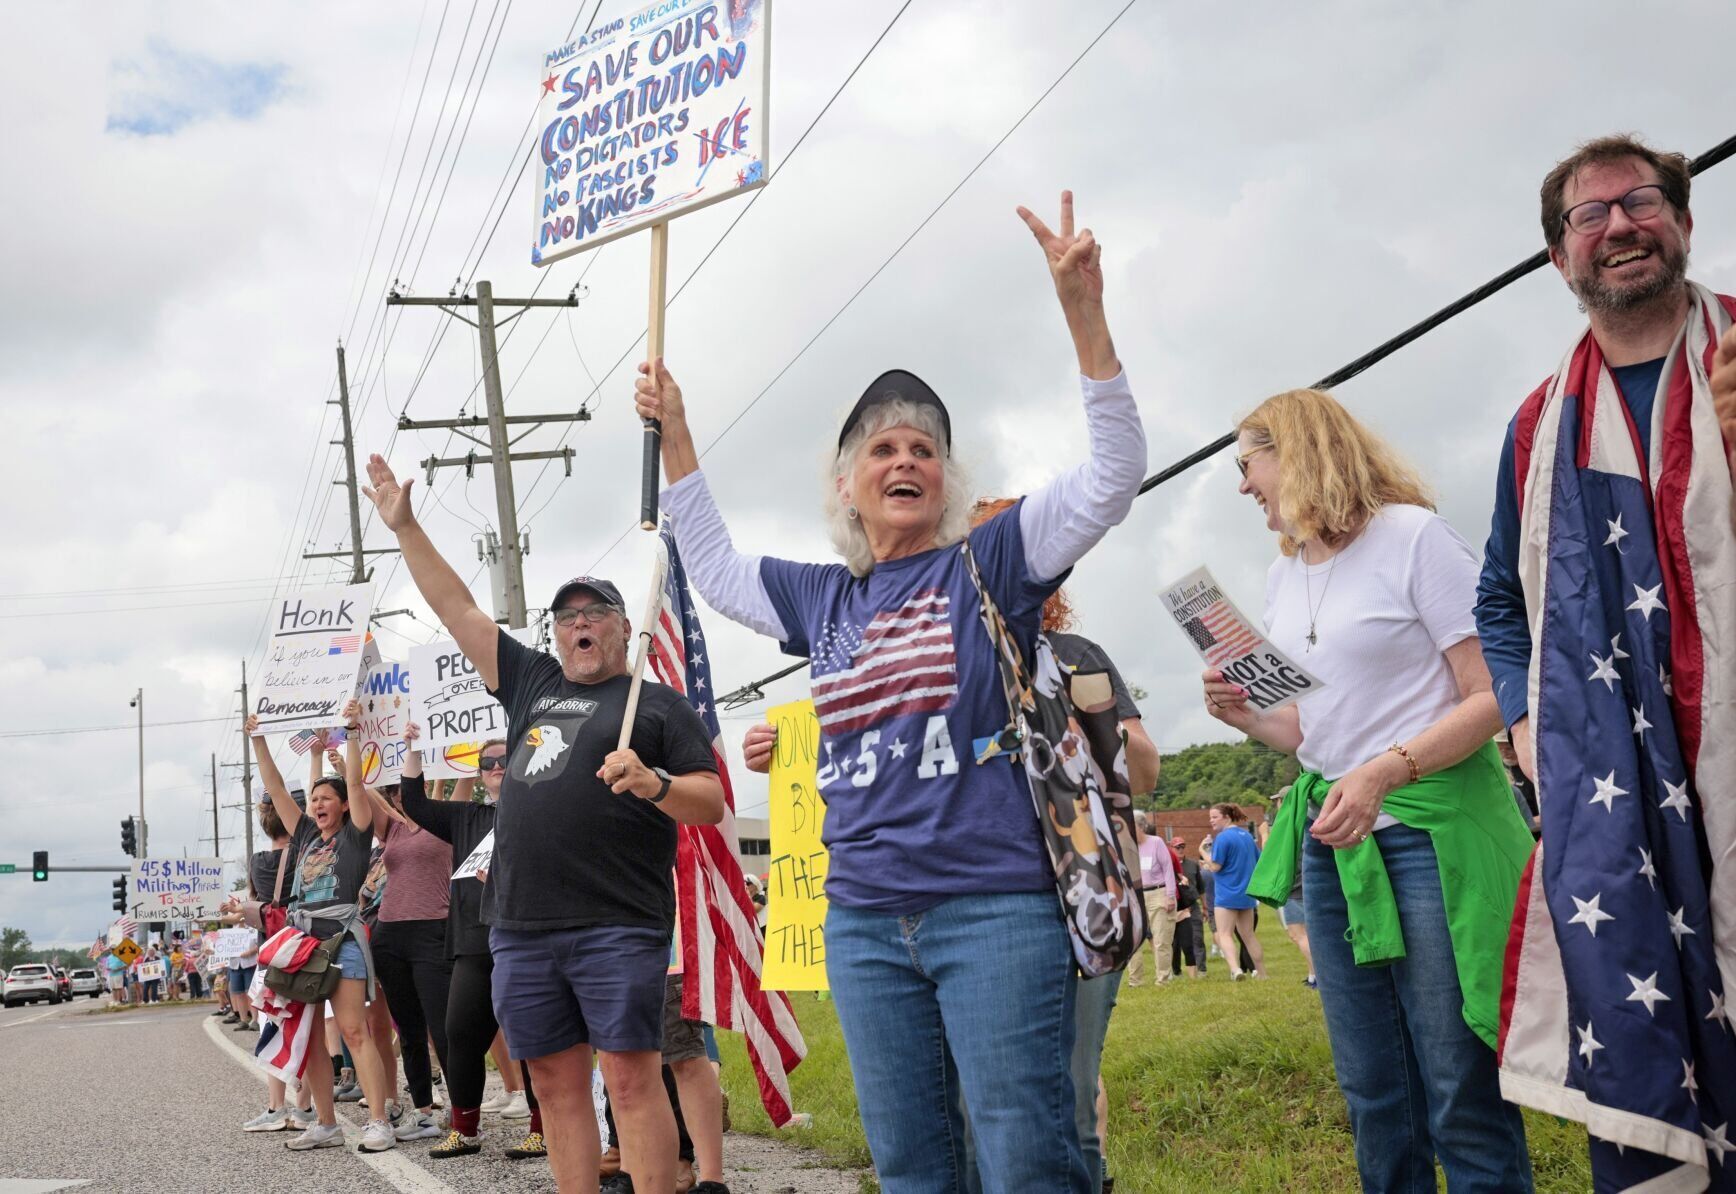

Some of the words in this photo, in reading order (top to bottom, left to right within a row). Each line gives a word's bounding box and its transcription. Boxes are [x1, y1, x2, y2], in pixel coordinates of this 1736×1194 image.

[545, 41, 576, 67] MAKE
[578, 35, 588, 50] A
[591, 18, 624, 44] STAND
[629, 11, 655, 32] SAVE
[557, 41, 640, 111] SAVE
[648, 5, 720, 65] OUR
[541, 41, 746, 166] CONSTITUTION
[544, 159, 572, 189] NO
[576, 107, 690, 173] DICTATORS
[698, 107, 752, 168] ICE
[576, 140, 678, 205] FASCISTS
[540, 216, 575, 248] NO
[575, 175, 656, 240] KINGS
[1168, 591, 1183, 607] We
[1180, 584, 1200, 601] have
[1199, 580, 1206, 590] a
[1173, 585, 1223, 623] CONSTITUTION
[435, 652, 477, 681] PEO
[1219, 653, 1269, 685] NOT
[1265, 653, 1283, 667] a
[1243, 665, 1312, 710] KING
[357, 714, 399, 742] MAKE
[791, 782, 817, 835] BY
[771, 851, 825, 901] THE
[772, 924, 826, 967] THE
